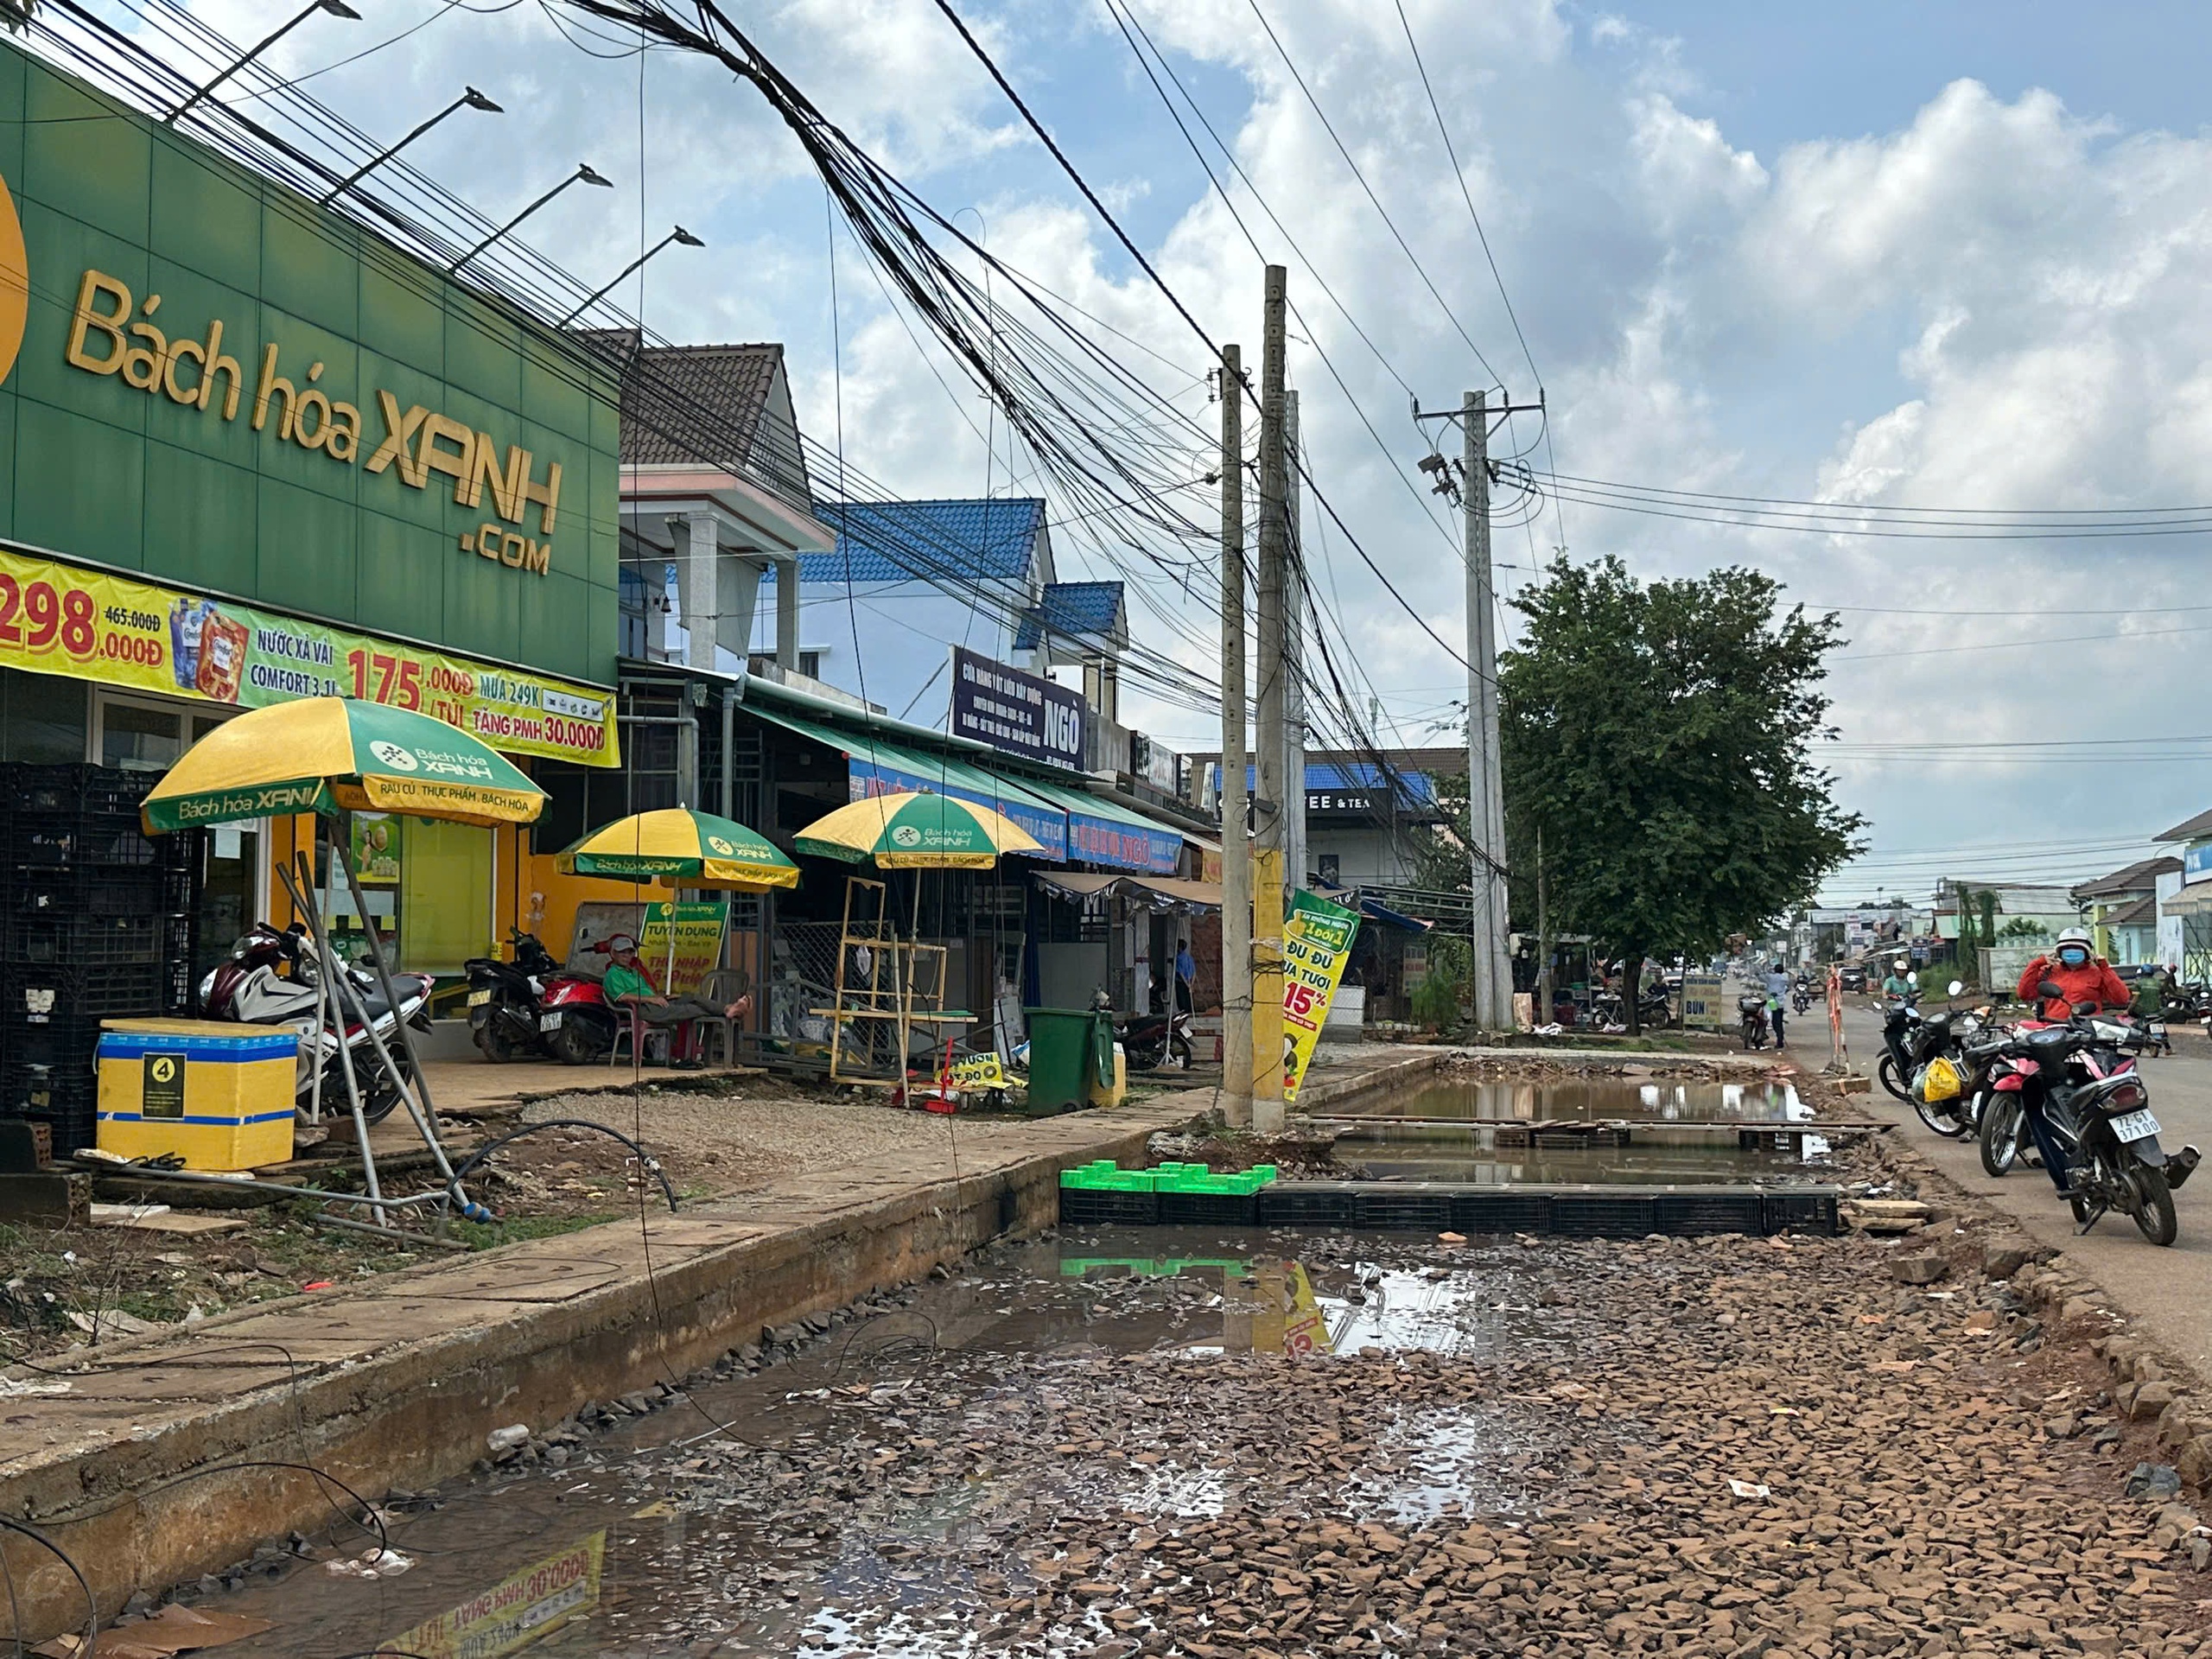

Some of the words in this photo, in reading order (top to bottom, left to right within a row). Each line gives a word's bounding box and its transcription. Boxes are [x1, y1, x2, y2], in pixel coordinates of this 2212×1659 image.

[67, 270, 241, 422] Bách
[251, 342, 361, 463] hóa
[364, 389, 562, 535] XANH
[461, 523, 551, 575] .COM
[0, 573, 96, 655] 298
[99, 632, 163, 665] .000Đ
[104, 606, 161, 632] 465.000Đ
[257, 629, 293, 657] NƯỚC
[295, 633, 310, 660] XẢ
[314, 638, 333, 665] VẢI
[251, 664, 310, 695] COMFORT
[348, 650, 420, 711] 175
[426, 667, 474, 696] .000Đ
[480, 675, 505, 701] MUA
[509, 683, 539, 707] 249K
[473, 709, 510, 738] TẶNG
[513, 719, 542, 740] PMH
[544, 716, 605, 750] 30.000Đ
[1044, 699, 1080, 755] NGÒ
[415, 748, 455, 764] Bách
[460, 753, 486, 766] hóa
[421, 760, 493, 779] XANH
[179, 798, 219, 820] Bách
[223, 793, 253, 813] hóa
[381, 783, 399, 794] RAU
[403, 781, 416, 794] CỦ
[423, 785, 446, 798] THỰC
[449, 785, 476, 802] PHẨM
[481, 792, 505, 807] BÁCH
[509, 798, 529, 812] HÓA
[1348, 798, 1370, 809] TEA
[922, 836, 971, 847] XANH
[925, 828, 950, 836] Bách
[951, 828, 972, 837] hóa
[643, 861, 682, 871] XANH
[735, 848, 773, 860] XANH
[685, 927, 717, 938] DỤNG
[1306, 922, 1314, 934] 1
[1334, 929, 1344, 946] 1
[1287, 941, 1308, 959] ĐU
[1301, 969, 1331, 990] TƯƠI
[1284, 982, 1327, 1015] 15%
[156, 1062, 169, 1078] 4
[2116, 1111, 2148, 1128] 72-G1
